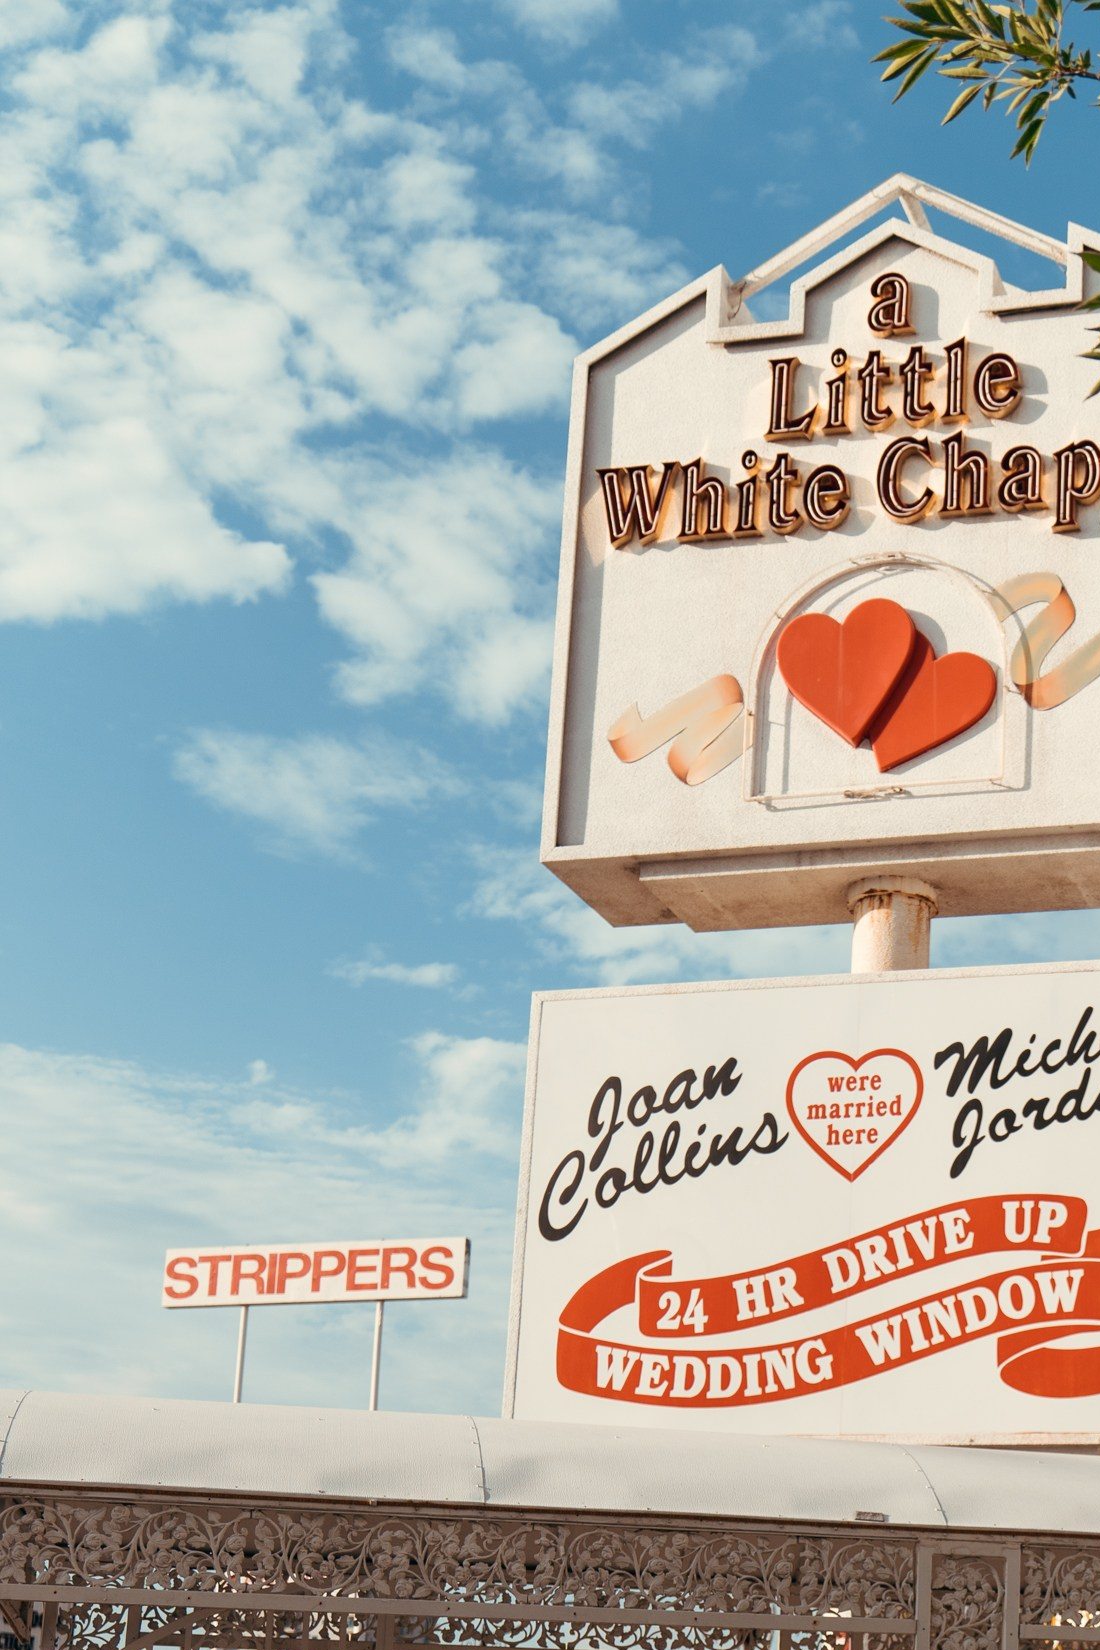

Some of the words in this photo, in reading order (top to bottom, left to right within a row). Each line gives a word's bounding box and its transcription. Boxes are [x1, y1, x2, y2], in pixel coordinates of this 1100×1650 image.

[868, 272, 916, 336] a
[765, 337, 1023, 442] Little
[597, 449, 852, 550] White
[587, 1056, 743, 1170] Joan
[806, 1095, 902, 1121] married
[826, 1073, 882, 1092] were
[537, 1111, 790, 1242] Collins
[826, 1124, 879, 1146] here
[164, 1246, 455, 1299] STRIPPERS
[656, 1288, 708, 1334] 24
[735, 1266, 804, 1323] HR
[822, 1207, 975, 1295] DRIVE
[1002, 1200, 1069, 1244] UP
[594, 1336, 835, 1400] WEDDING
[855, 1268, 1085, 1367] WINDOW
